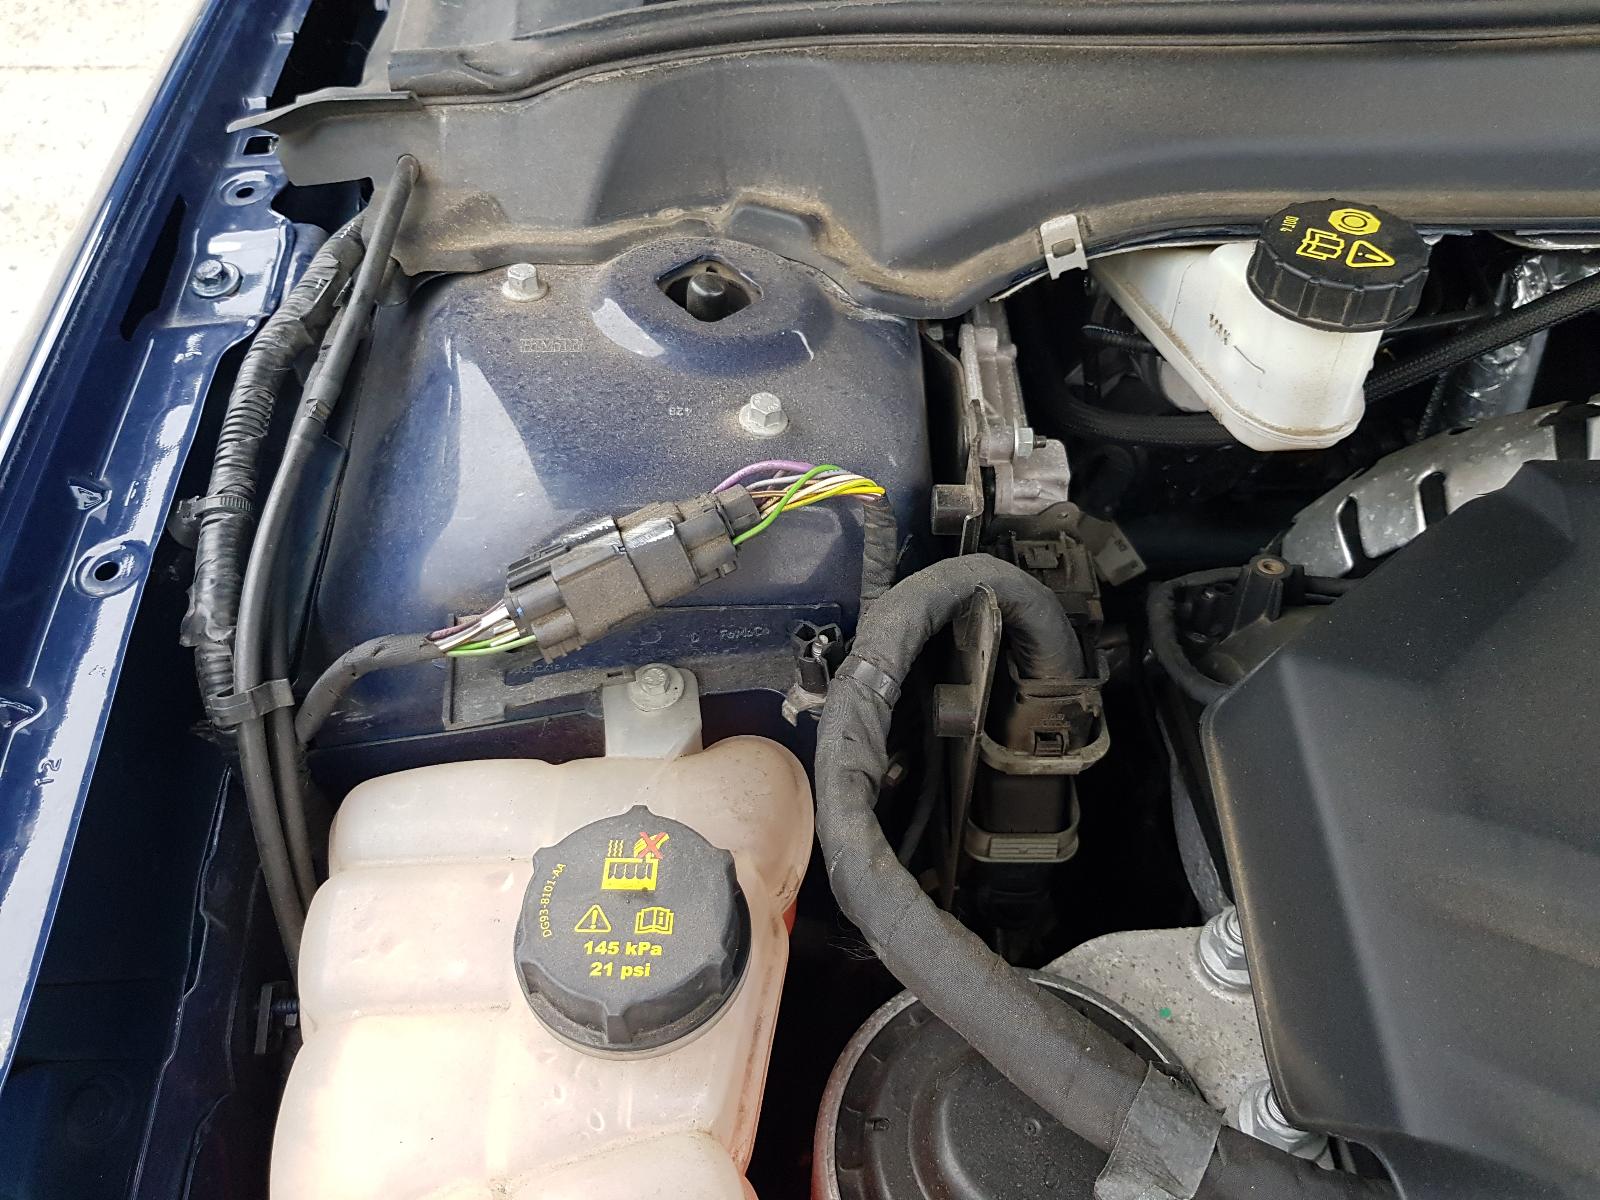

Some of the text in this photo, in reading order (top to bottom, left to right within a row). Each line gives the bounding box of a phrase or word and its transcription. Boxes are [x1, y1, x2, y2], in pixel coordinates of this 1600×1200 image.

[538, 863, 567, 938] DG93-8101-AA
[584, 940, 664, 956] 145 kPa
[590, 962, 651, 980] 21 psi
